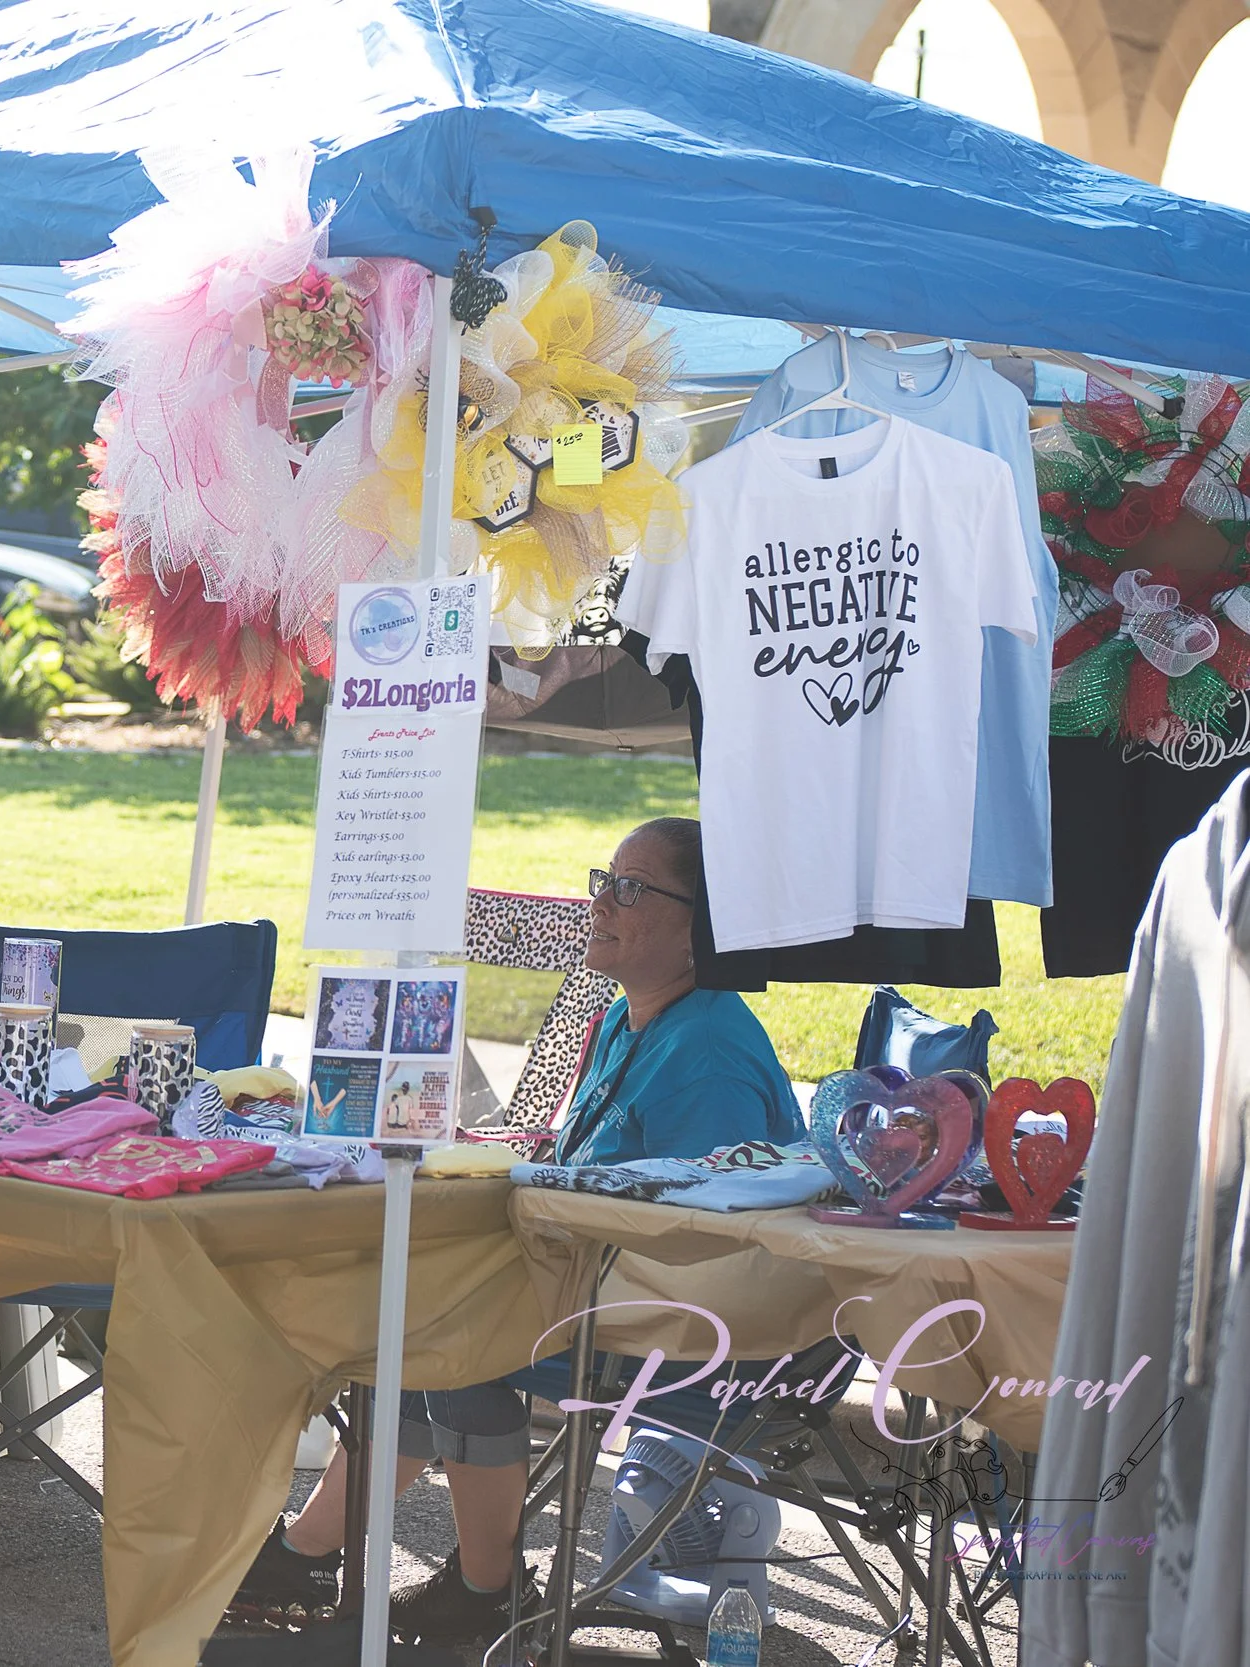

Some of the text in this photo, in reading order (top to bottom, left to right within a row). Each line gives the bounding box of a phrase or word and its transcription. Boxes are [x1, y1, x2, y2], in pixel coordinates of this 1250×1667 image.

[745, 528, 920, 578] allergic to
[745, 570, 919, 636] NEGATIVE
[378, 615, 415, 632] CREATIONS
[753, 626, 906, 715] energy
[342, 673, 476, 712] $2Longoria
[384, 750, 414, 760] $15.00
[338, 768, 363, 780] Kids
[336, 788, 360, 800] Kids
[335, 810, 356, 824] Key
[332, 850, 356, 862] Kids
[330, 872, 362, 886] Epoxy
[325, 909, 417, 921] Prices on Wreaths
[13, 975, 23, 983] DO
[720, 1643, 759, 1656] AQUAFIN
